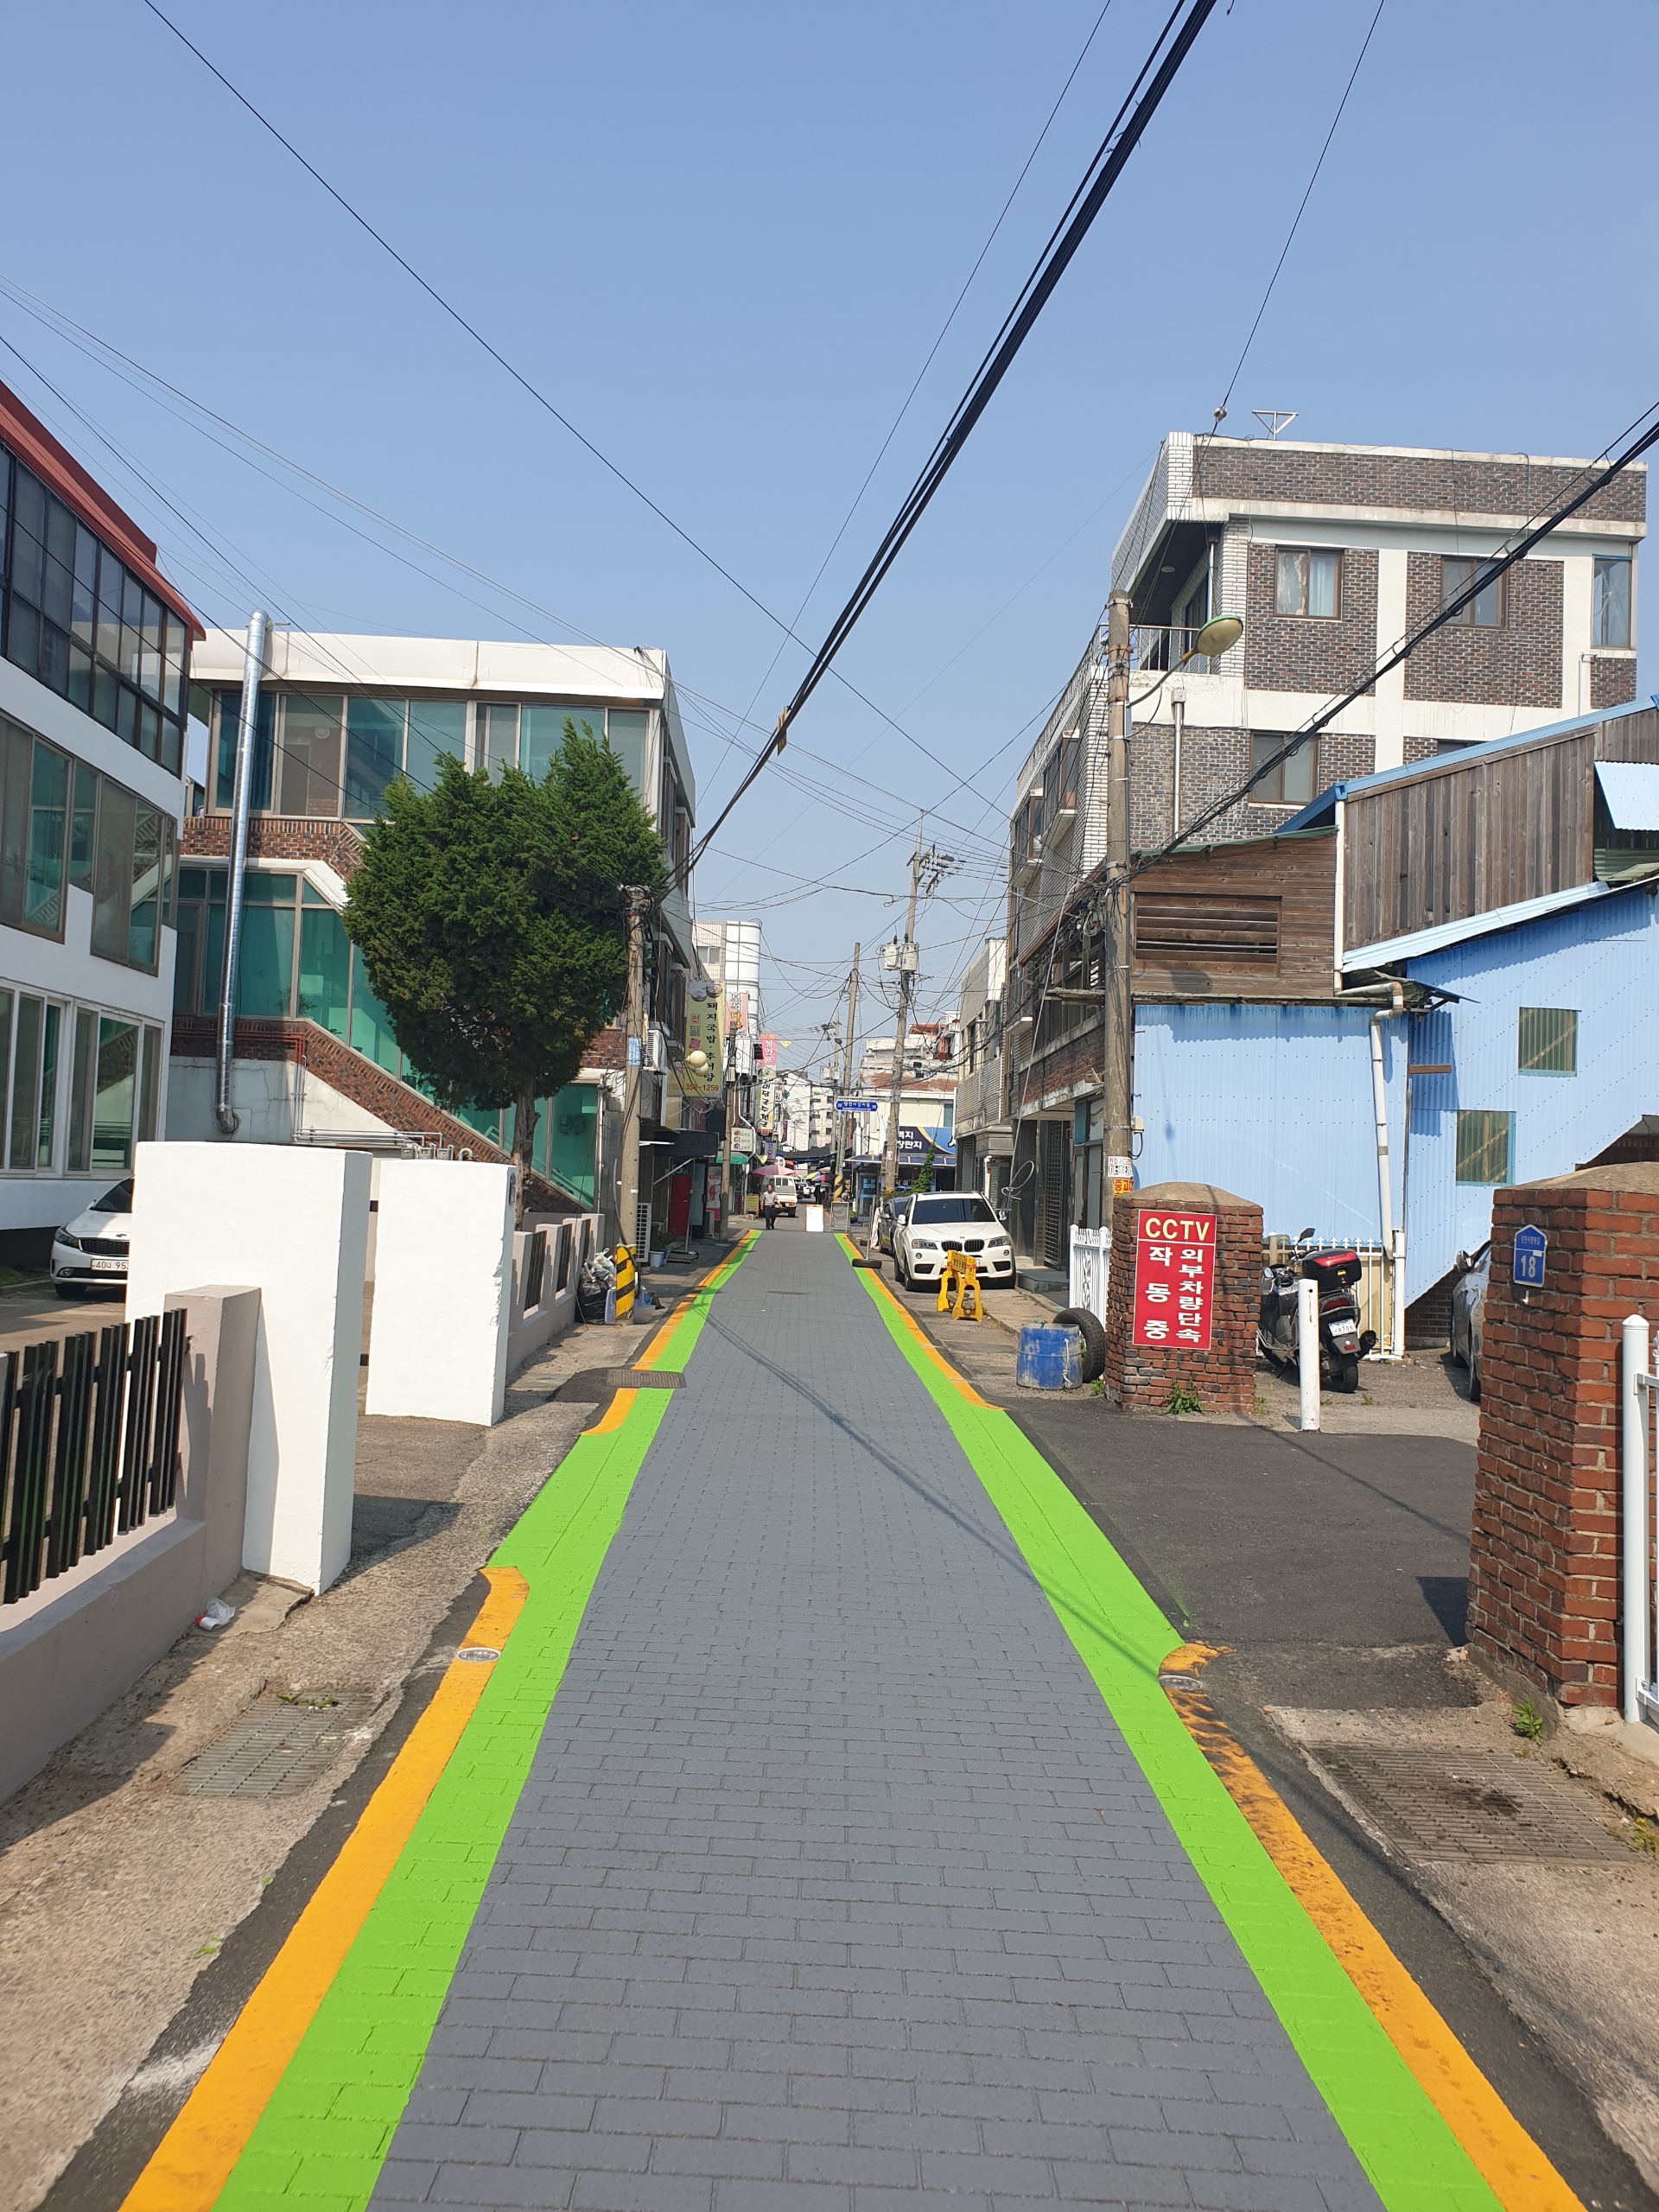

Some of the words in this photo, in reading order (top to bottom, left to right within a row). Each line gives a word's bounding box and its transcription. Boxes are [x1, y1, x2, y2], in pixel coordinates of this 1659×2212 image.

[1145, 1217, 1210, 1242] CCTV
[1521, 1255, 1536, 1278] 18
[1144, 1246, 1173, 1339] 작동중
